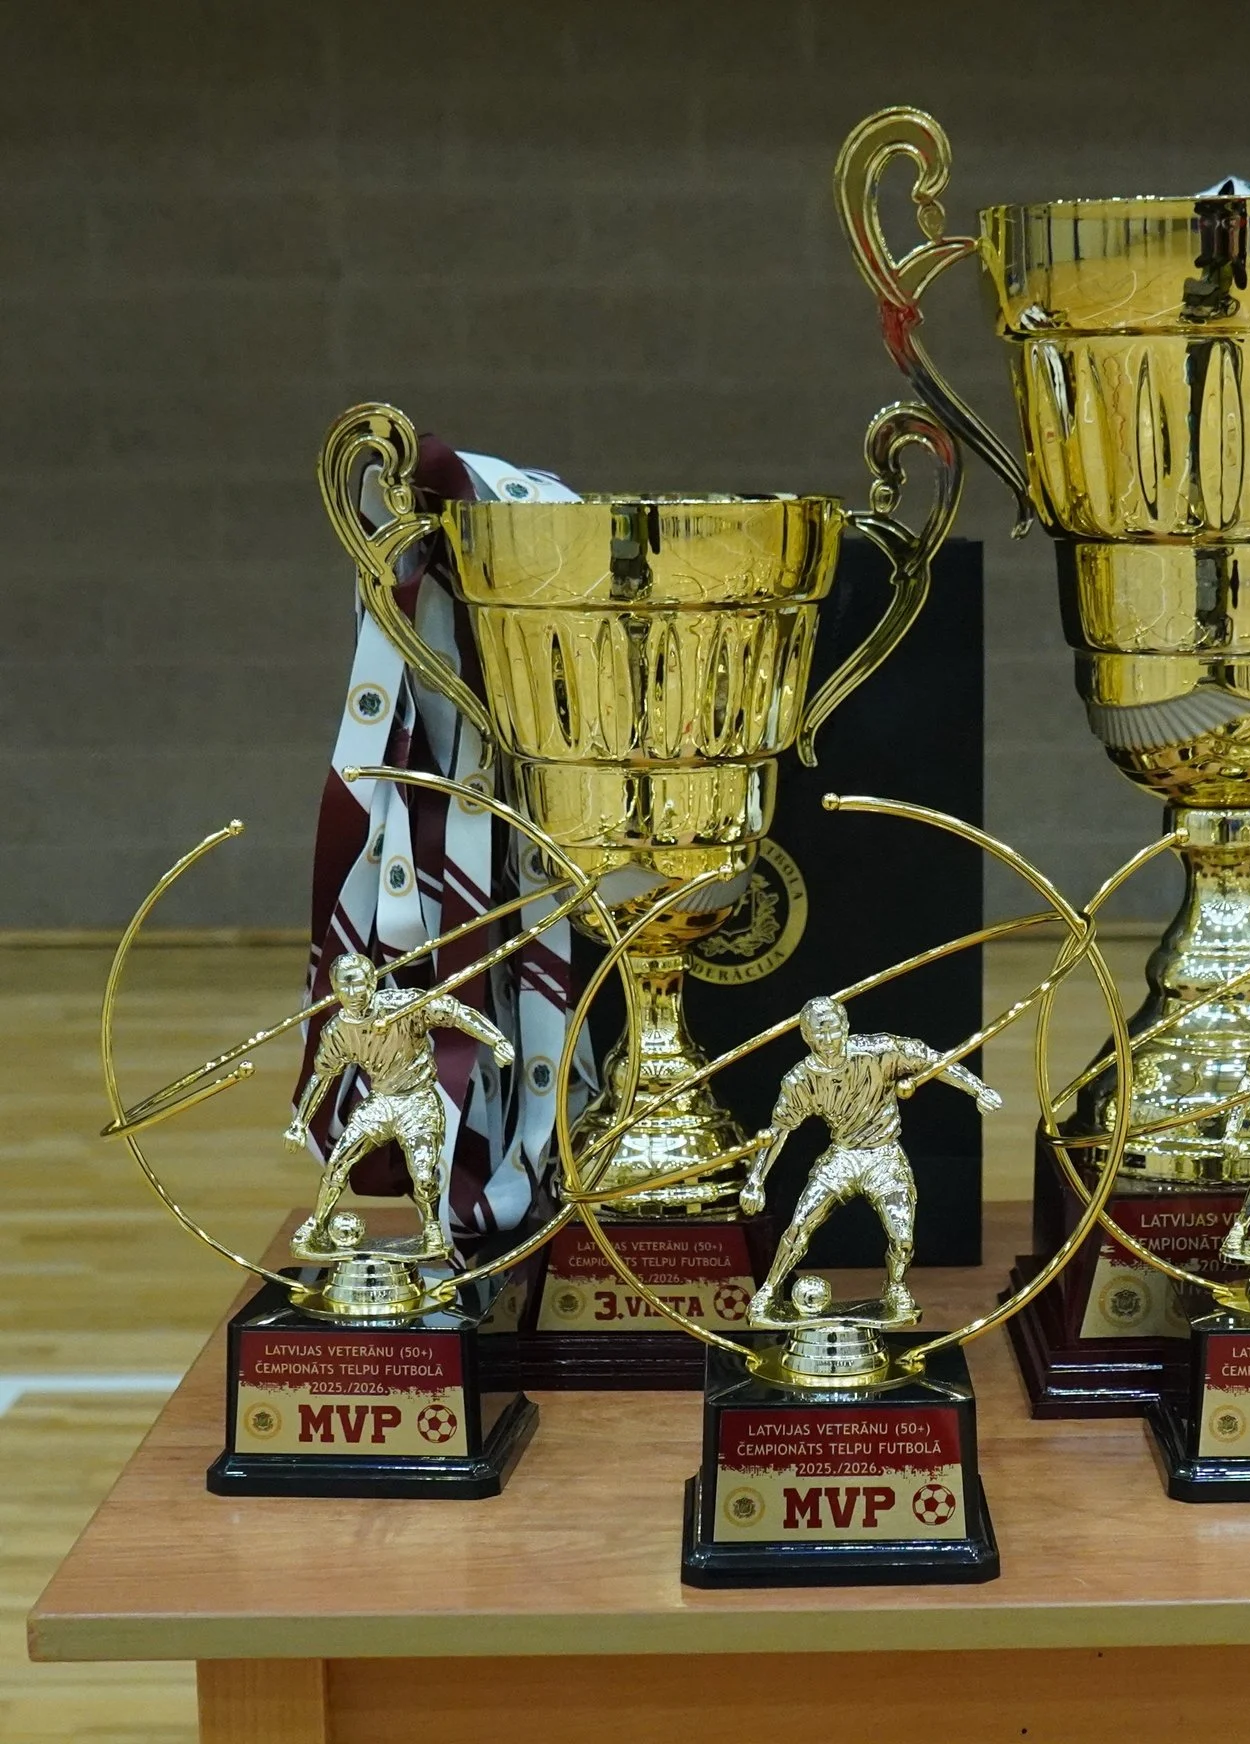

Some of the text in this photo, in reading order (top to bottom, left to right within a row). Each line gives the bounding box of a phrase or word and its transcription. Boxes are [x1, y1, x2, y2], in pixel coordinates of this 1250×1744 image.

[1141, 1213, 1216, 1228] LATVIJAS
[577, 1240, 723, 1253] LATAS VETERĀNU (50+)
[1130, 1234, 1223, 1251] EMPIONĀT
[569, 1256, 731, 1267] ČEMPIOTS TELPU FUTBOLĀ
[265, 1344, 433, 1360] LATVIJAS VETERĀNU (50+)
[255, 1361, 443, 1377] ČEMPIONĀTS TELPU FUTBOLĀ
[312, 1382, 388, 1394] 2025./2026.
[298, 1404, 402, 1444] MVP
[748, 1421, 931, 1437] LATVIJAS VETERĀNU (50+)
[737, 1440, 942, 1456] ČEMPIONĀTS TELPU FUTBOLĀ
[799, 1462, 882, 1475] 2025./2026.
[783, 1486, 896, 1529] MVP
